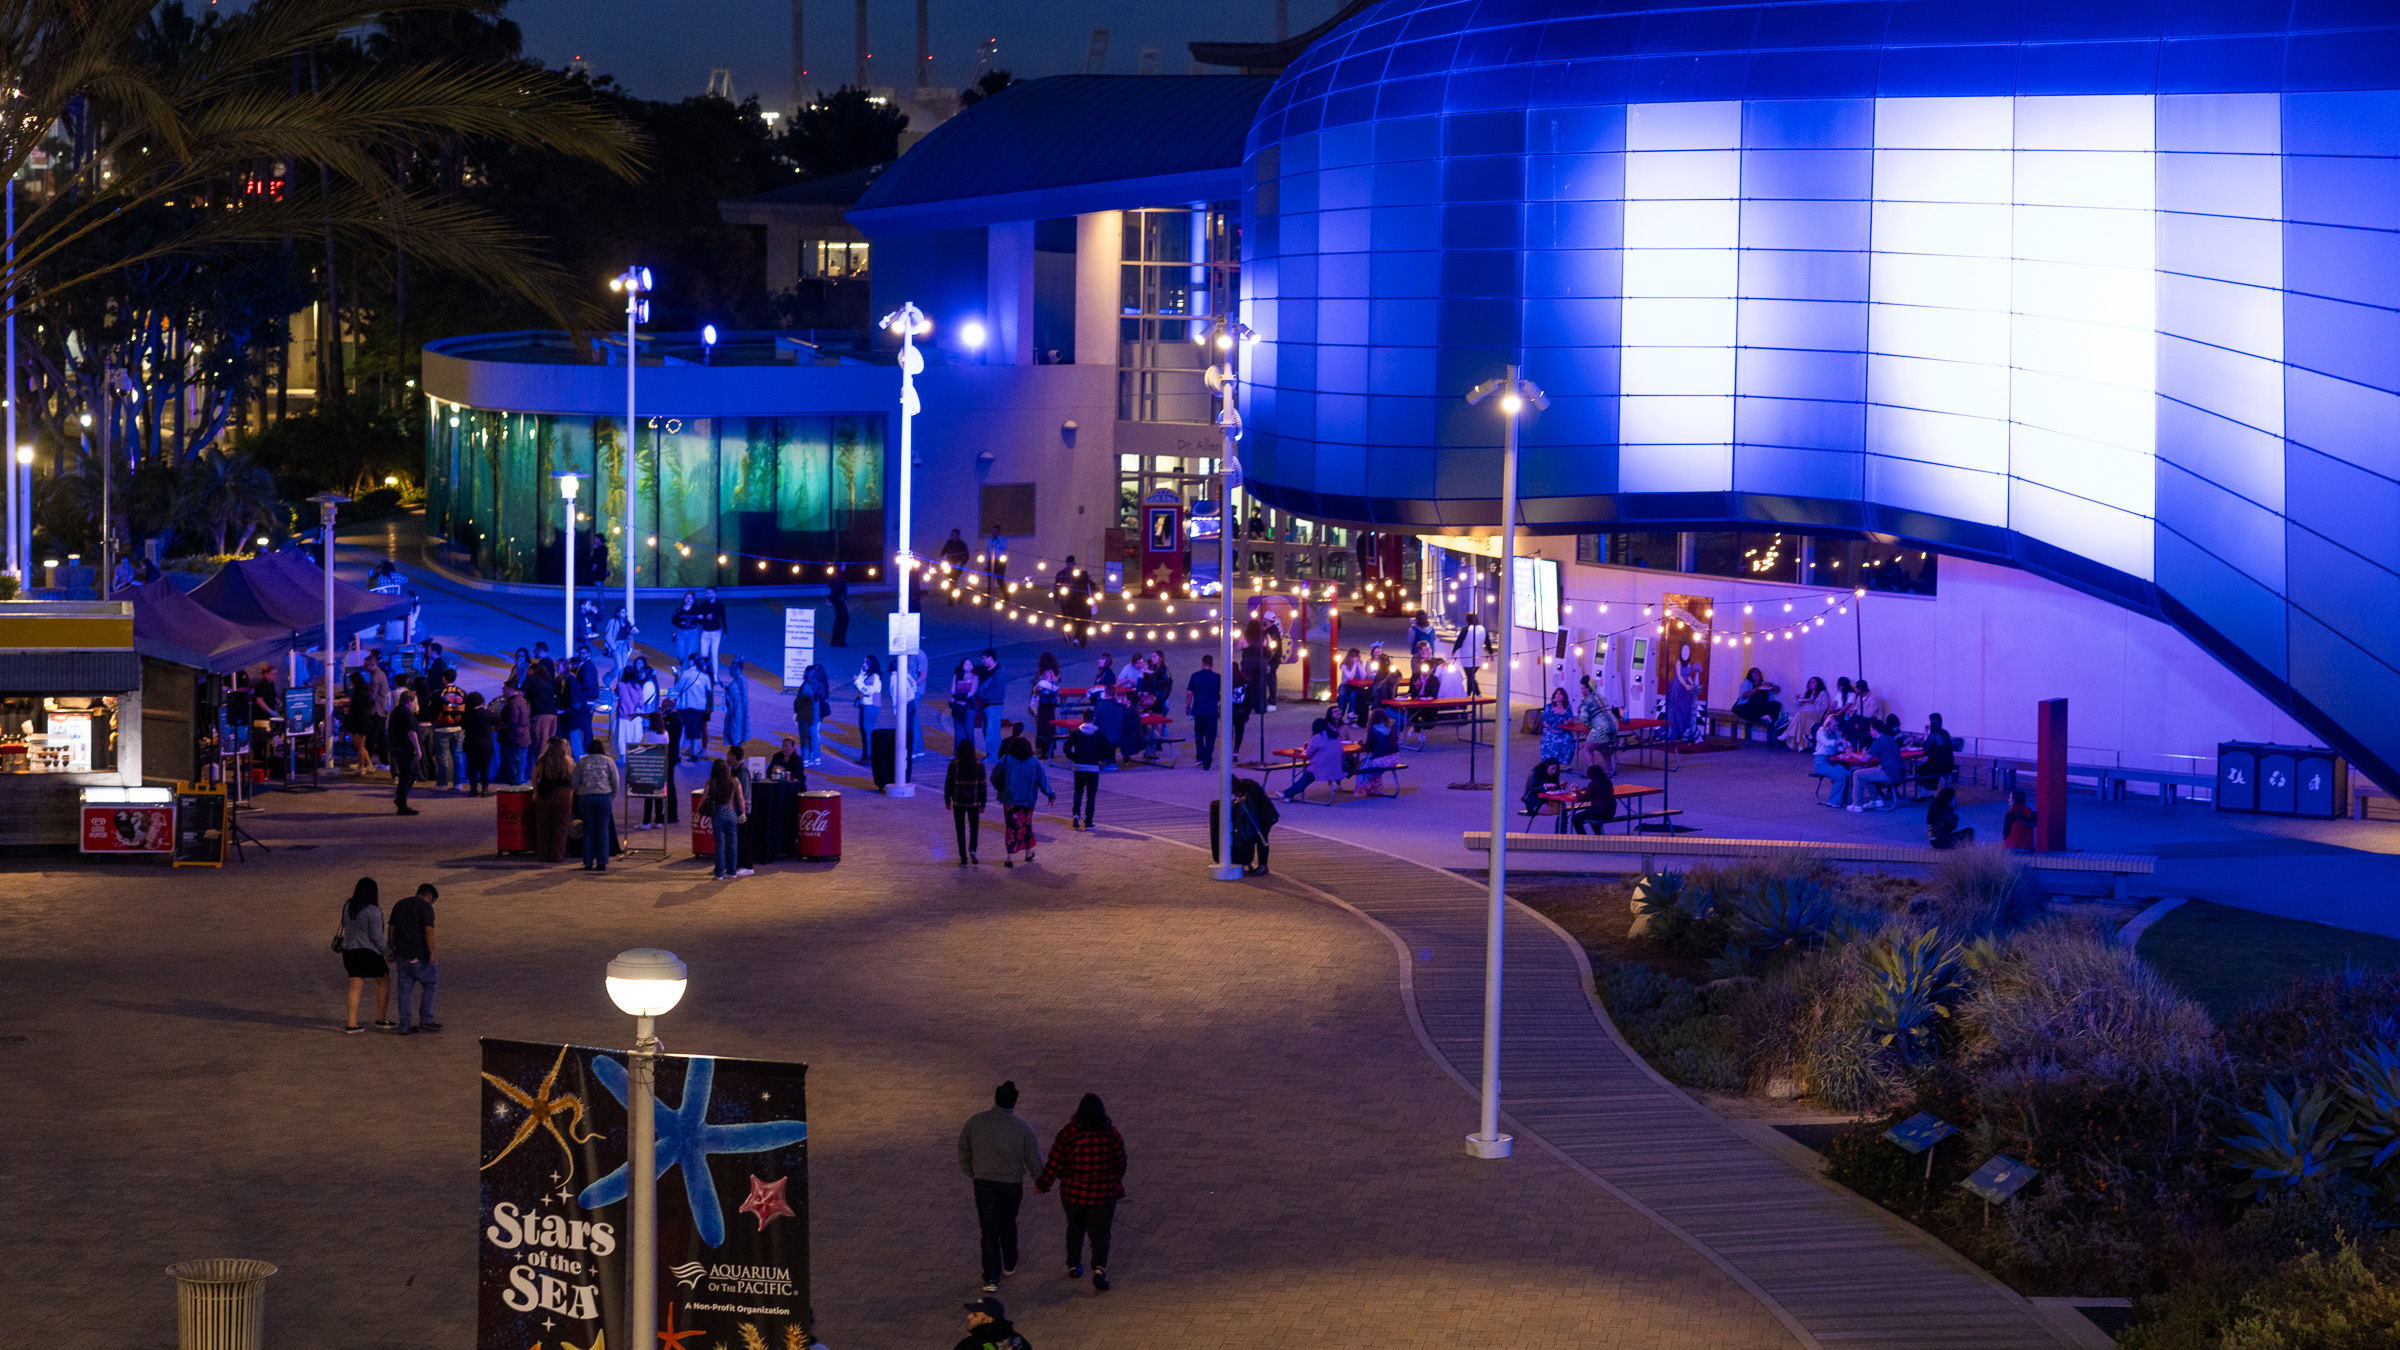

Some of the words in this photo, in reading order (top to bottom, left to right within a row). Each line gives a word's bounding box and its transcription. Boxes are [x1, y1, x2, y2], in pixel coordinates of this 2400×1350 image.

[1460, 556, 1467, 567] 5
[486, 1201, 616, 1257] Stars
[528, 1250, 549, 1268] of
[550, 1254, 582, 1275] the
[708, 1263, 792, 1281] AQUARIUM
[502, 1264, 600, 1320] SEA
[684, 1302, 692, 1310] A
[693, 1302, 736, 1313] Non-Profit
[736, 1305, 790, 1315] Organization
